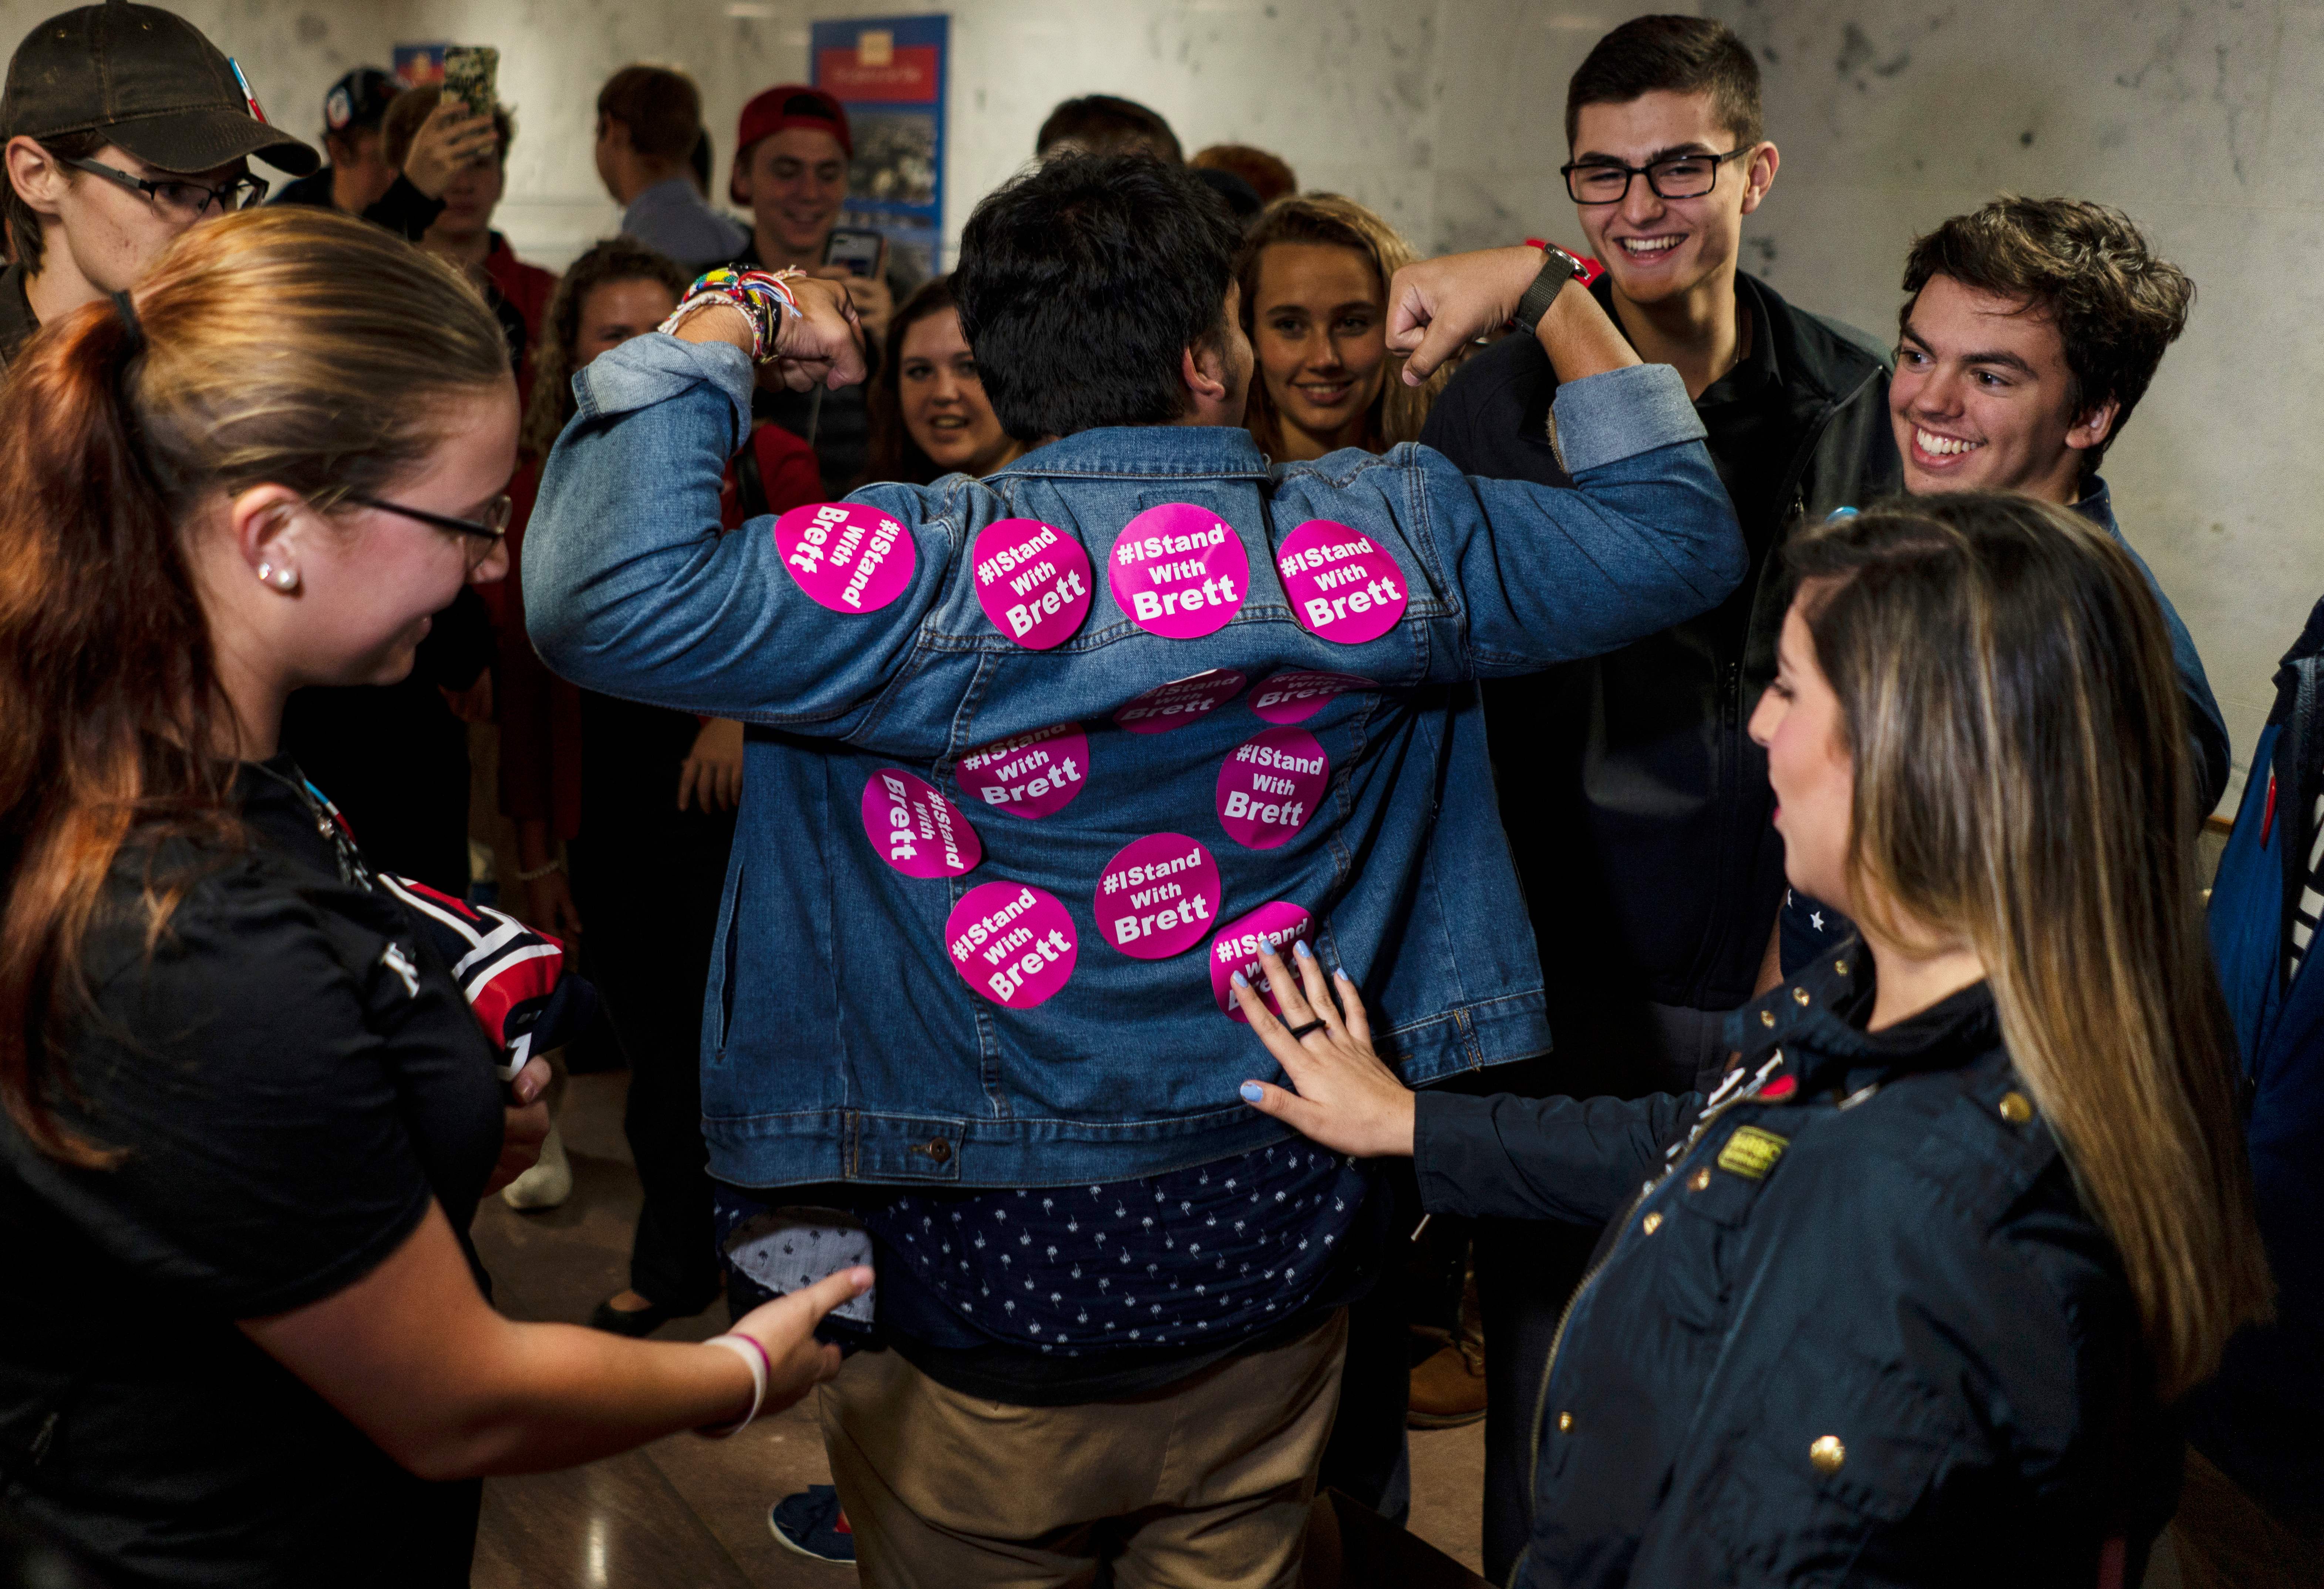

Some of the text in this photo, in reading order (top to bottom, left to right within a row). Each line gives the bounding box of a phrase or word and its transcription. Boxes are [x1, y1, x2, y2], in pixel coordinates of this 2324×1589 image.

[789, 506, 850, 573] Brett
[829, 525, 865, 567] With
[977, 526, 1058, 586] #IStand
[1117, 524, 1225, 565] #IStand
[1280, 538, 1374, 578] #IStand
[841, 519, 900, 609] #IStand
[1010, 559, 1056, 596] With
[1149, 559, 1206, 585] With
[1314, 563, 1367, 592] With
[1006, 569, 1086, 638] Brett
[1132, 575, 1238, 621] Brett
[1305, 576, 1402, 628] Brett
[1120, 697, 1215, 720] Brett
[1257, 686, 1349, 708] Brett
[996, 750, 1049, 782] With
[1236, 744, 1323, 775] #IStand
[981, 756, 1081, 805] Brett
[1253, 773, 1295, 795] With
[882, 774, 917, 860] Brett
[913, 801, 935, 839] With
[1224, 791, 1303, 826] Brett
[927, 790, 964, 869] #IStand
[1104, 848, 1202, 895] #IStand
[1130, 882, 1181, 909] With
[952, 888, 1037, 963] #IStand
[1115, 893, 1209, 945] Brett
[983, 925, 1033, 966] With
[988, 929, 1072, 1002] Brett
